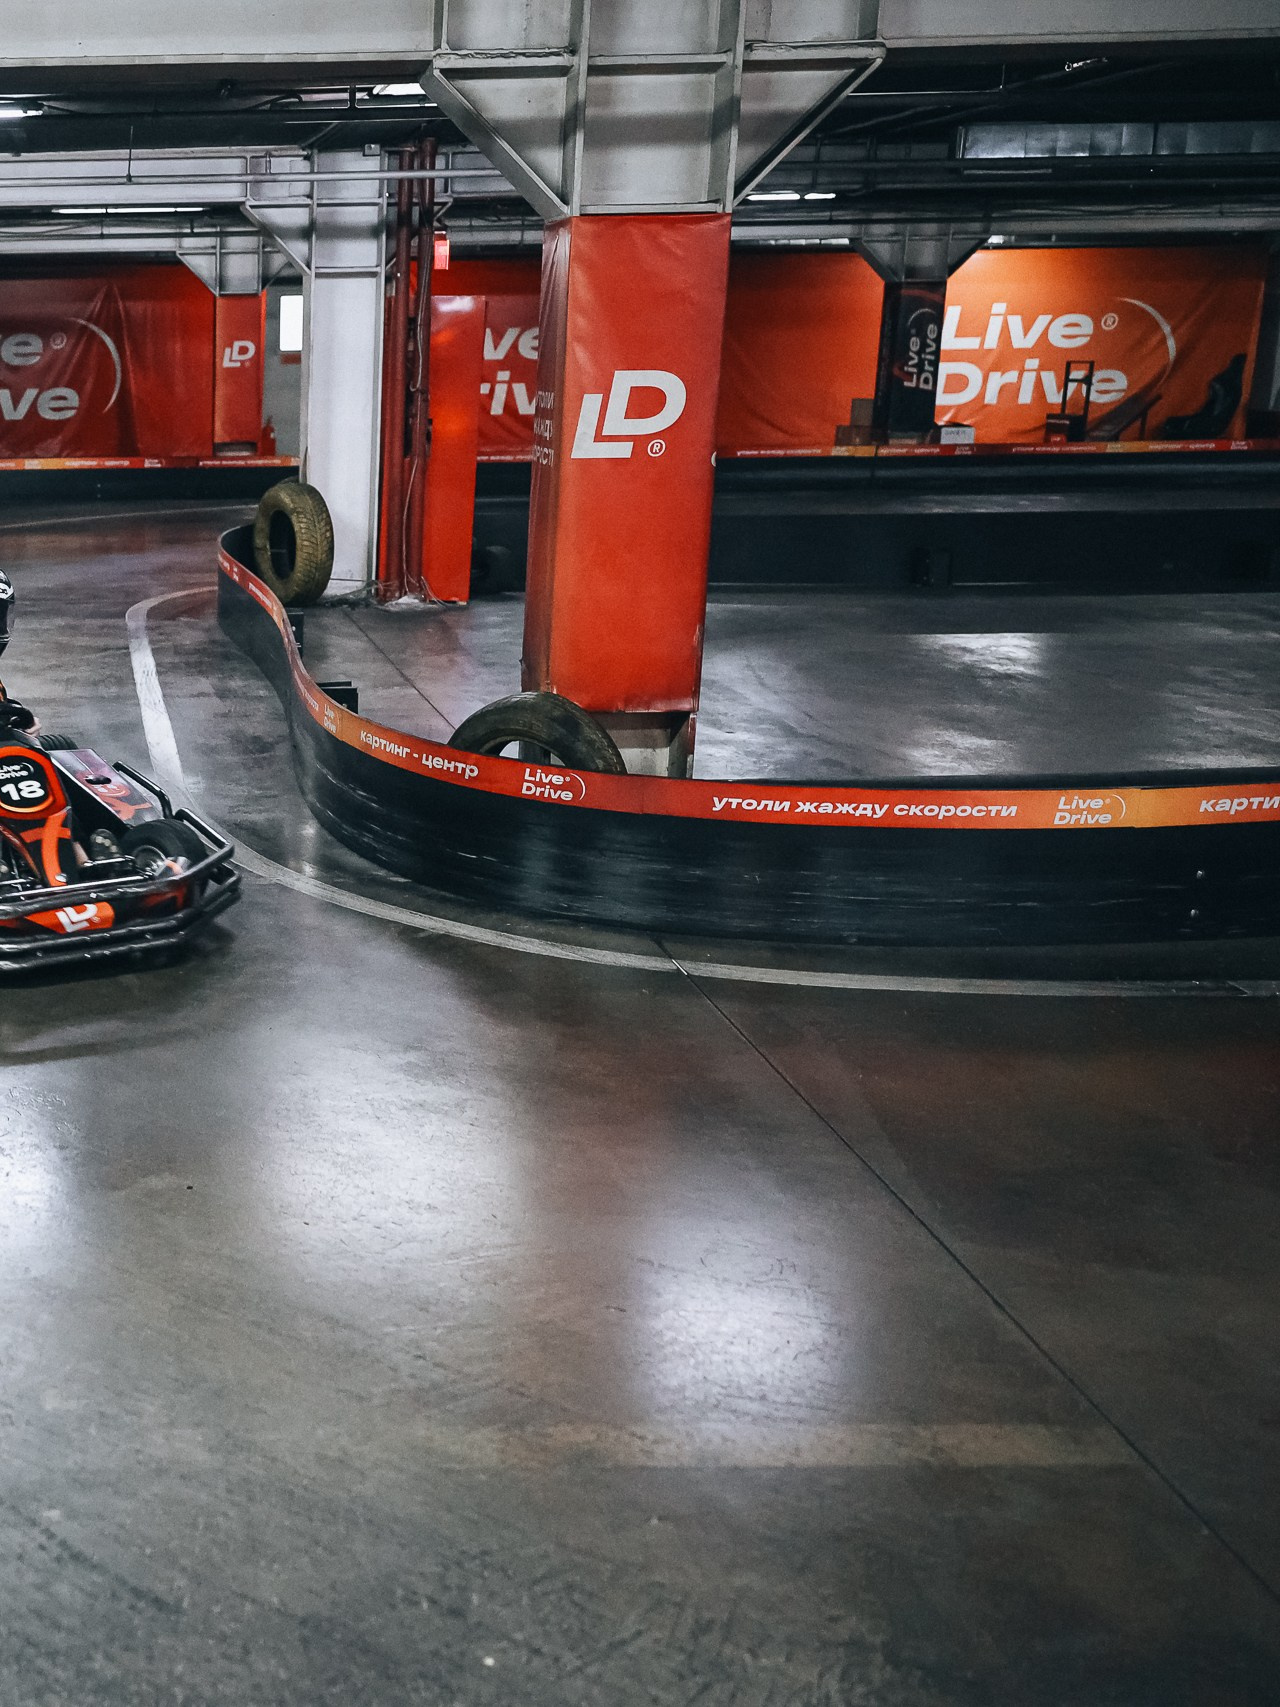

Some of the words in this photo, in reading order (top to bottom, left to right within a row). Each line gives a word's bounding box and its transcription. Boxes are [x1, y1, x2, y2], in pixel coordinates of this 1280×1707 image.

[483, 327, 539, 360] ve
[919, 323, 938, 390] Drive
[935, 358, 1128, 406] Drive
[360, 730, 410, 758] картинг
[422, 753, 479, 780] центр
[0, 780, 45, 801] 18
[521, 782, 574, 801] Drive
[712, 796, 790, 812] утоли
[794, 801, 890, 819] жажду
[893, 804, 1018, 820] скорости
[1053, 811, 1113, 825] Drive
